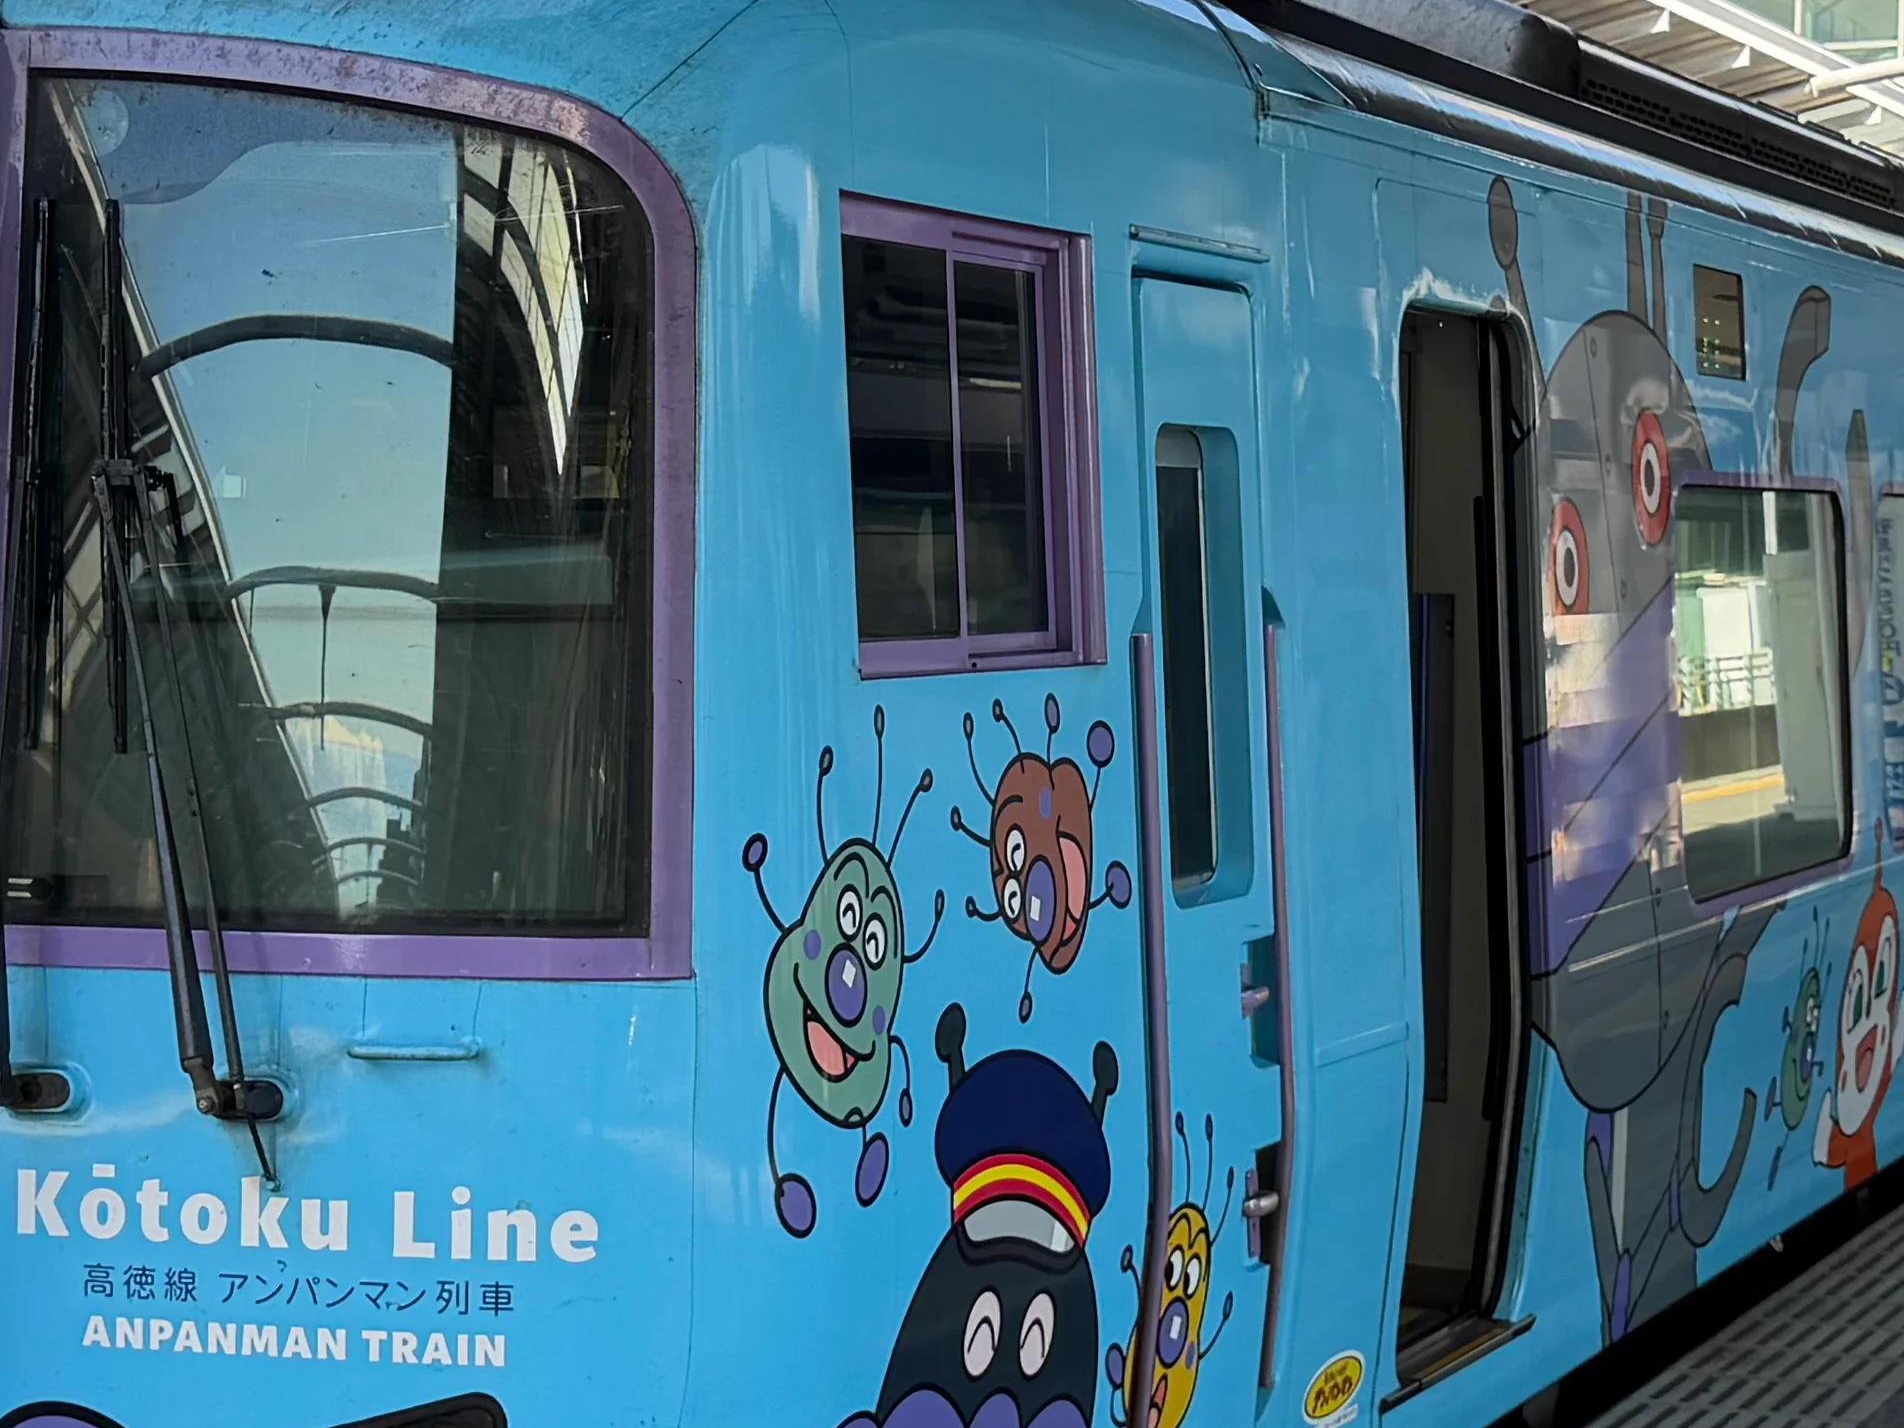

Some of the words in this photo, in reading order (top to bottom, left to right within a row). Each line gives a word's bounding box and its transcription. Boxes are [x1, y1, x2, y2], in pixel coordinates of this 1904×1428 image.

[16, 1163, 349, 1251] Kōtoku
[392, 1185, 599, 1263] Line
[82, 1262, 198, 1303] 高徳線
[218, 1271, 515, 1316] アンパンマン列車
[82, 1315, 347, 1361] ANPANMAN
[361, 1329, 507, 1367] TRAIN
